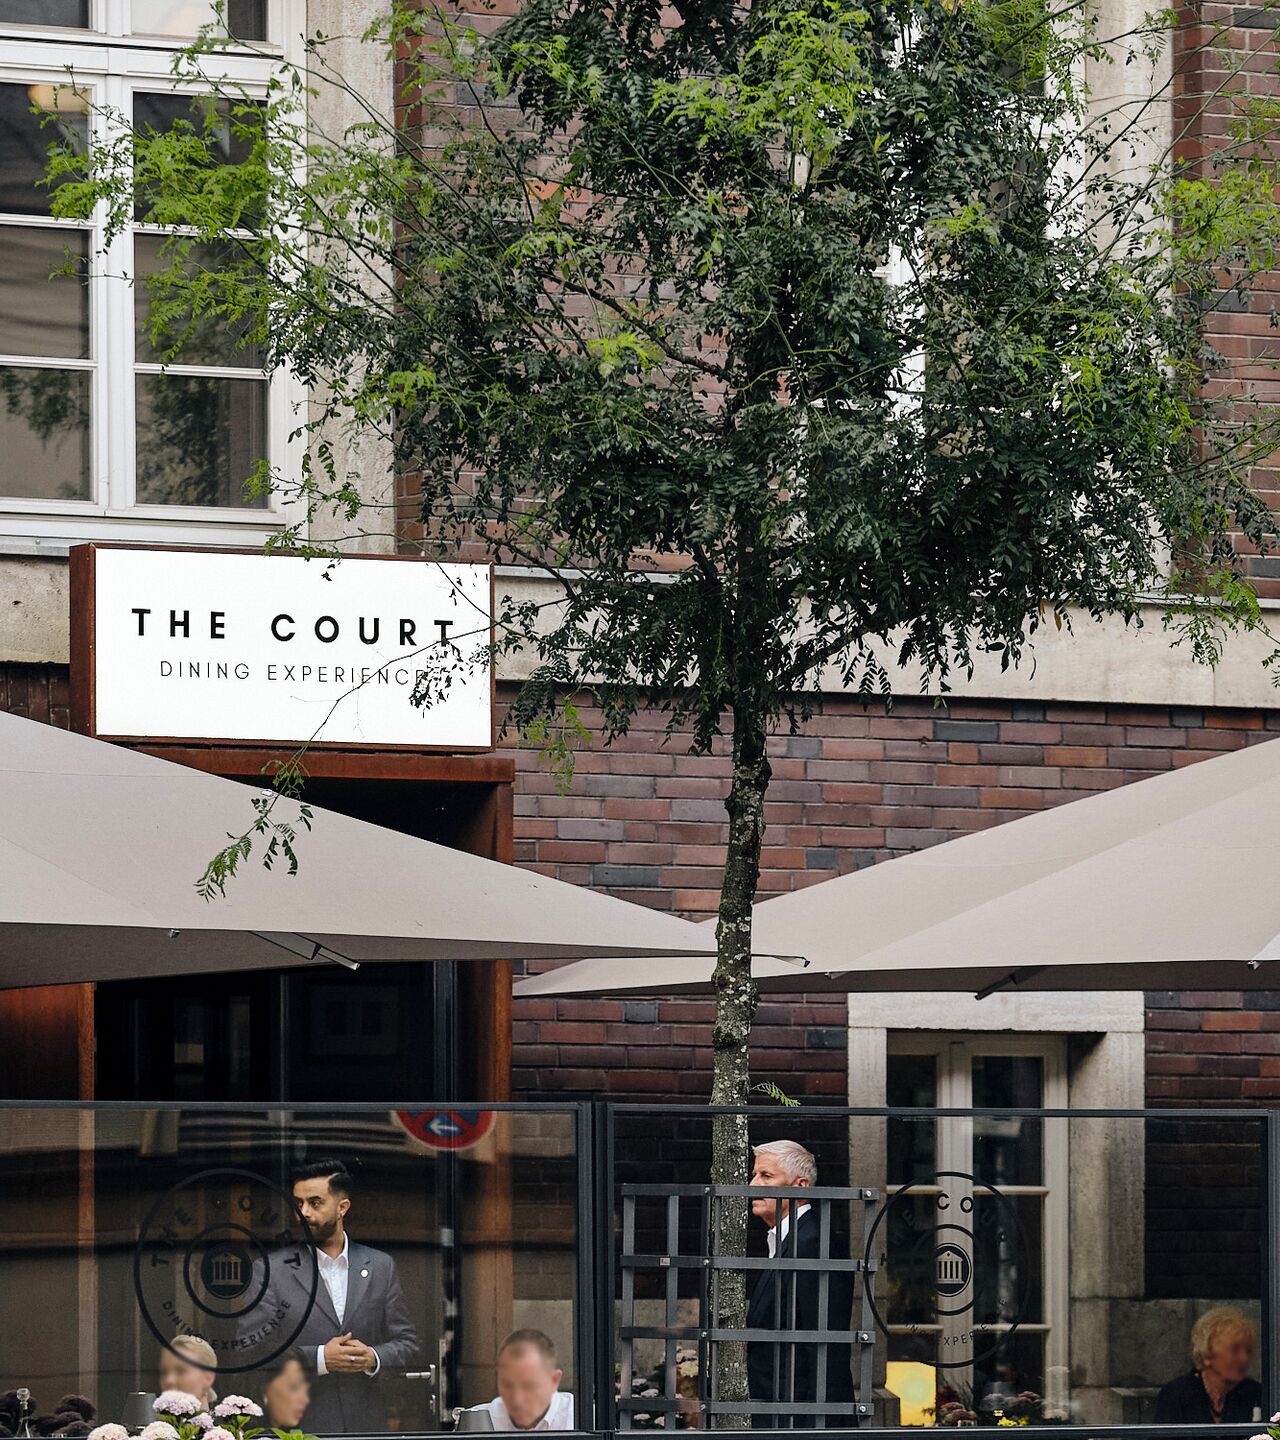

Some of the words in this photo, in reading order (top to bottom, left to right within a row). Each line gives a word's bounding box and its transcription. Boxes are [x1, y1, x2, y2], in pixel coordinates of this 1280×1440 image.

[131, 608, 225, 639] THE
[271, 614, 454, 647] COURT
[160, 661, 250, 680] DINING
